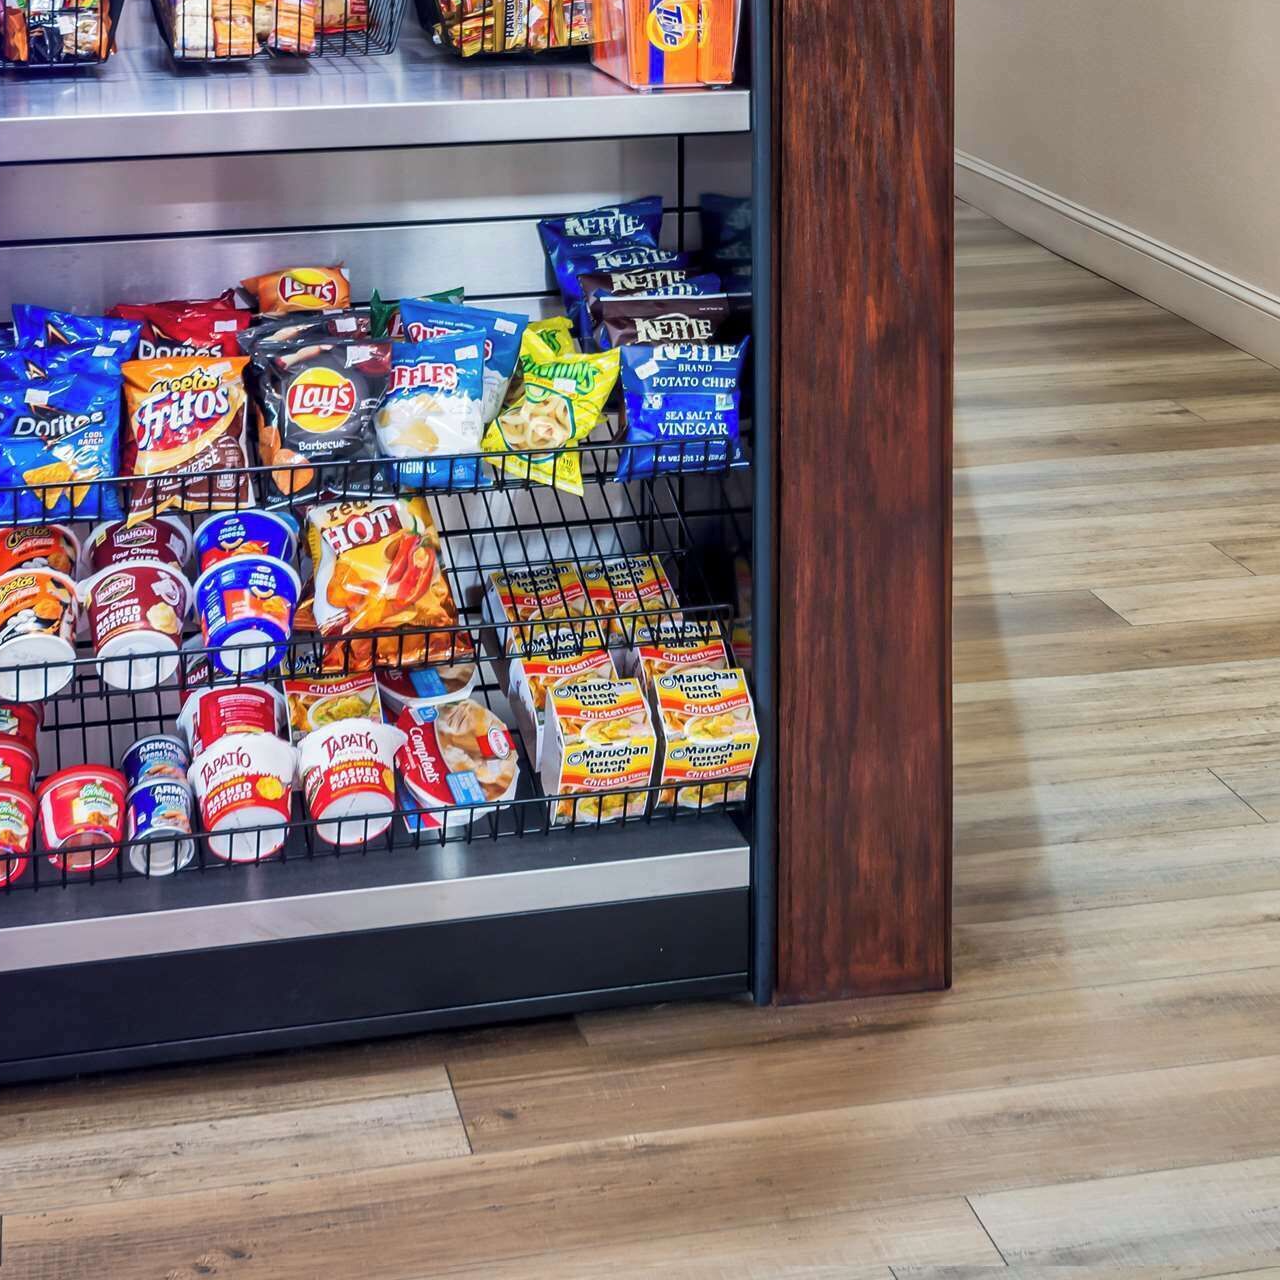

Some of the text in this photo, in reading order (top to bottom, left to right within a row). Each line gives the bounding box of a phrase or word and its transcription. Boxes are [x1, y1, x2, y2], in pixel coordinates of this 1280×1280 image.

[663, 4, 682, 46] Tide
[564, 208, 646, 237] KETTLE
[592, 246, 678, 270] KETTLE
[610, 269, 687, 293] KETTLE
[634, 313, 713, 343] KETTLE
[138, 342, 223, 360] Doritos
[652, 342, 740, 363] KETTLE
[678, 364, 713, 373] BRAND
[388, 362, 457, 394] UFFLES
[652, 376, 737, 388] POTATO CHIPS
[291, 384, 352, 417] Lay's
[138, 386, 229, 452] Fritos
[665, 410, 723, 421] SEA SALT &
[14, 410, 104, 437] Doritos
[658, 422, 729, 436] VINEGAR
[77, 438, 105, 446] RANCH
[83, 431, 103, 439] COOL
[298, 439, 346, 451] Barbecue
[393, 461, 437, 474] IGINAL
[5, 526, 51, 549] Cheetos
[116, 528, 156, 544] IDAHOAN
[218, 529, 247, 539] cheese
[220, 526, 236, 534] mac
[322, 508, 394, 556] HOT
[112, 547, 159, 562] Four Cheese
[248, 578, 277, 589] cheese
[251, 573, 267, 582] mac
[96, 577, 134, 603] IDAHOAN
[110, 597, 139, 611] Cheese
[523, 592, 564, 606] Chicken
[96, 604, 141, 634] MASHED
[97, 613, 141, 641] POTATOES
[651, 623, 713, 637] Maruchan
[534, 630, 597, 649] Maruchan
[662, 647, 724, 662] Chicken Flavor
[547, 653, 608, 675] Chicken Flavor
[673, 670, 737, 684] Maruchan
[308, 681, 353, 694] Chicken
[567, 680, 632, 694] Maruchan
[679, 682, 718, 693] Instan
[581, 696, 617, 707] Lunch
[685, 690, 721, 700] Lunch
[579, 703, 643, 719] Chicken Flavor
[683, 697, 747, 714] Chicken Flavor
[139, 741, 182, 755] ARMOU
[408, 726, 440, 785] Compleats
[582, 743, 649, 759] Maruchan
[685, 741, 751, 756] Maruchan
[586, 757, 631, 768] Instant
[688, 751, 733, 763] Instant
[692, 758, 727, 768] Lunch
[329, 767, 380, 784] MASHED
[589, 764, 626, 774] Lunch
[685, 762, 750, 779] Chicken Flavor
[330, 775, 381, 792] POTATOES
[582, 770, 649, 787] Chicken Flavor
[206, 781, 252, 811] MASHED
[207, 791, 253, 818] POTATOES
